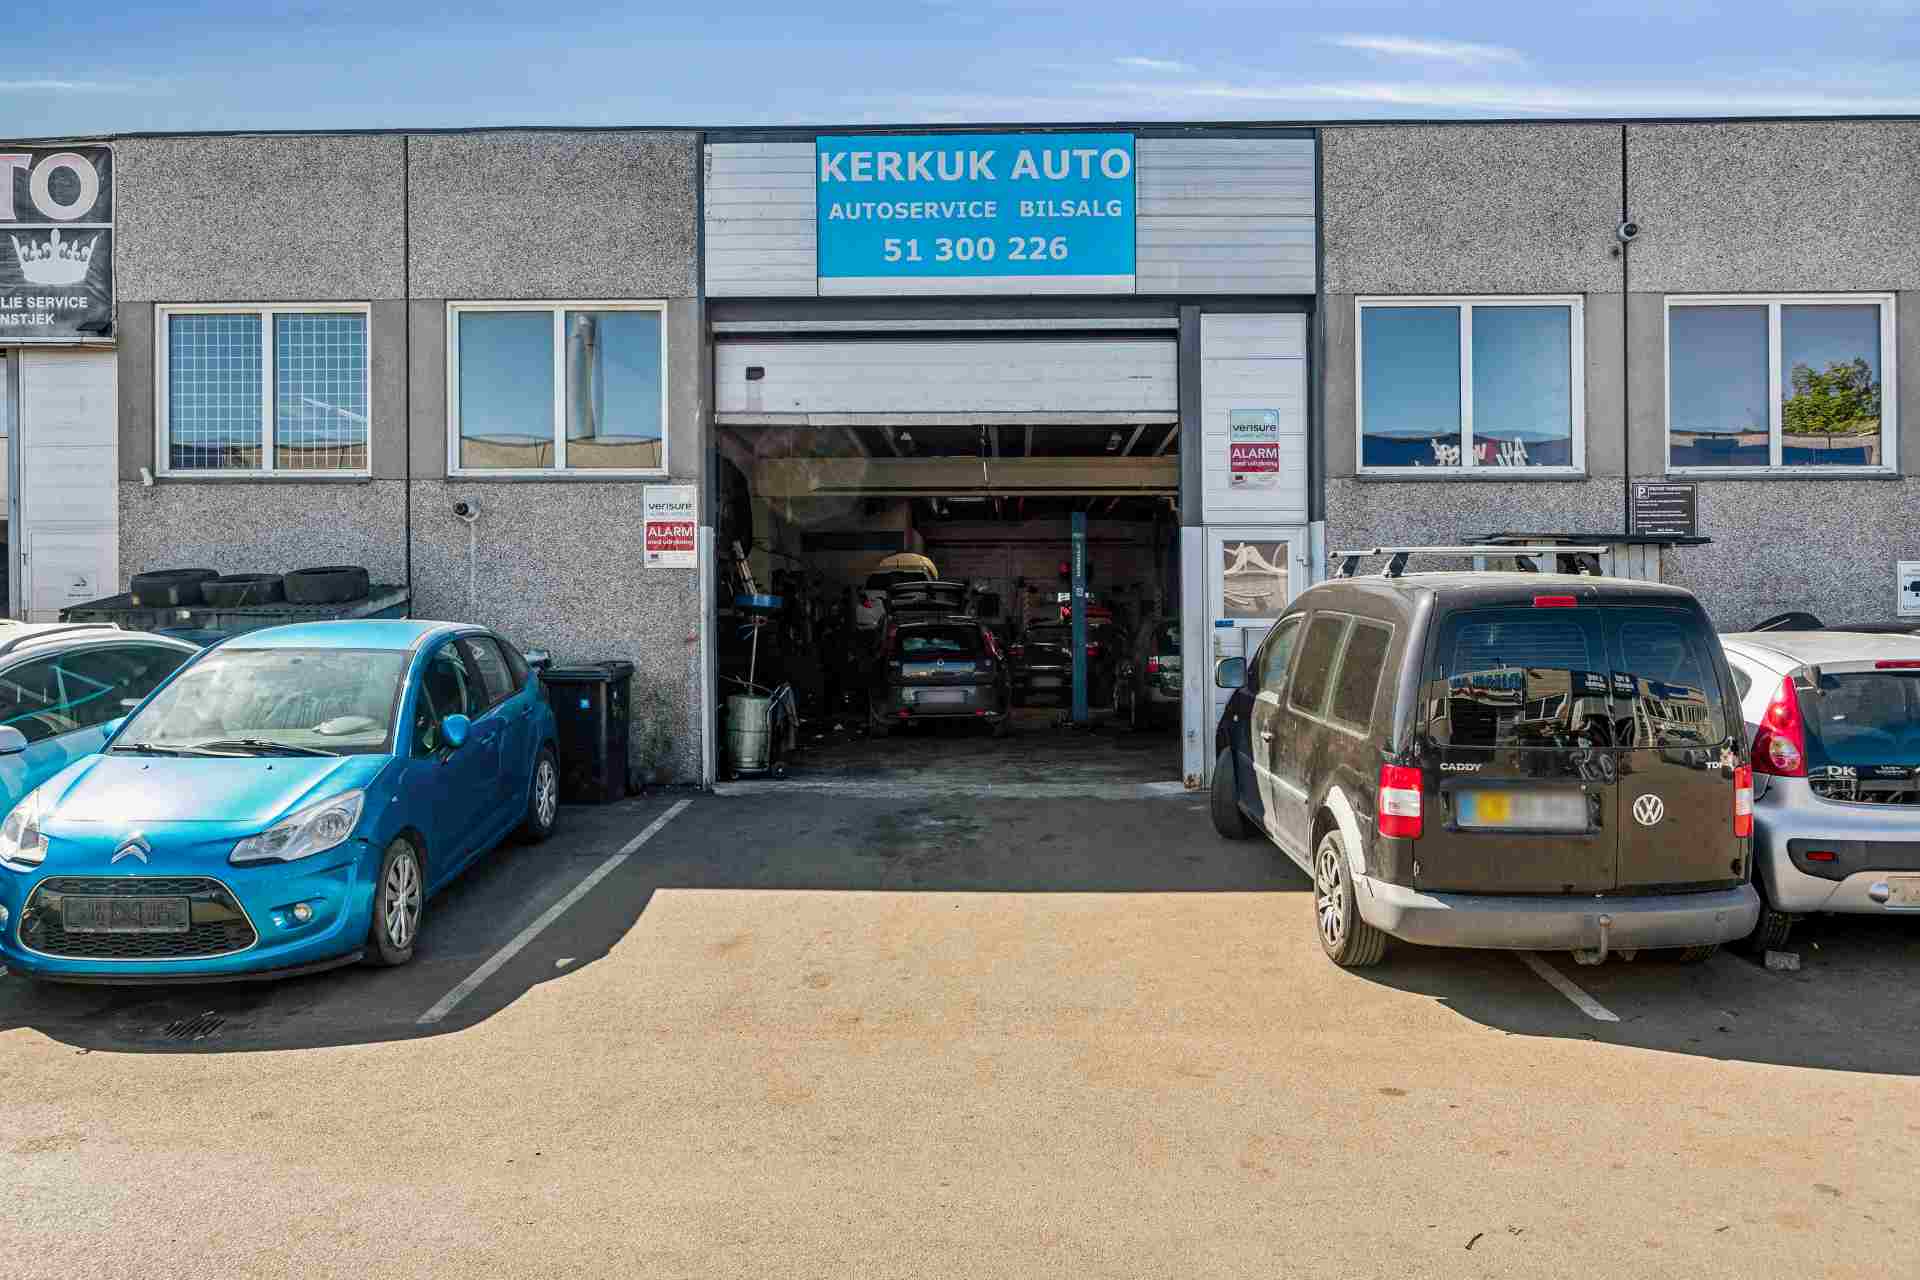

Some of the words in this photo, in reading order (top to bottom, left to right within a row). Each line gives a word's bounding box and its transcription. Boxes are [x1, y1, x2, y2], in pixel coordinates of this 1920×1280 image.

[820, 150, 996, 182] KERKUK
[1010, 148, 1131, 180] AUTO
[829, 201, 997, 220] AUTOSERVICE
[1020, 199, 1122, 217] BILSALG
[884, 238, 923, 262] 51
[935, 237, 996, 262] 300
[1008, 236, 1069, 260] 226
[0, 296, 23, 308] LIE
[26, 296, 88, 308] SERVICE
[1232, 424, 1277, 432] verisure
[1232, 447, 1278, 459] ALARM
[648, 526, 693, 538] ALARM
[1439, 762, 1482, 772] CADDY
[1827, 764, 1858, 777] DK
